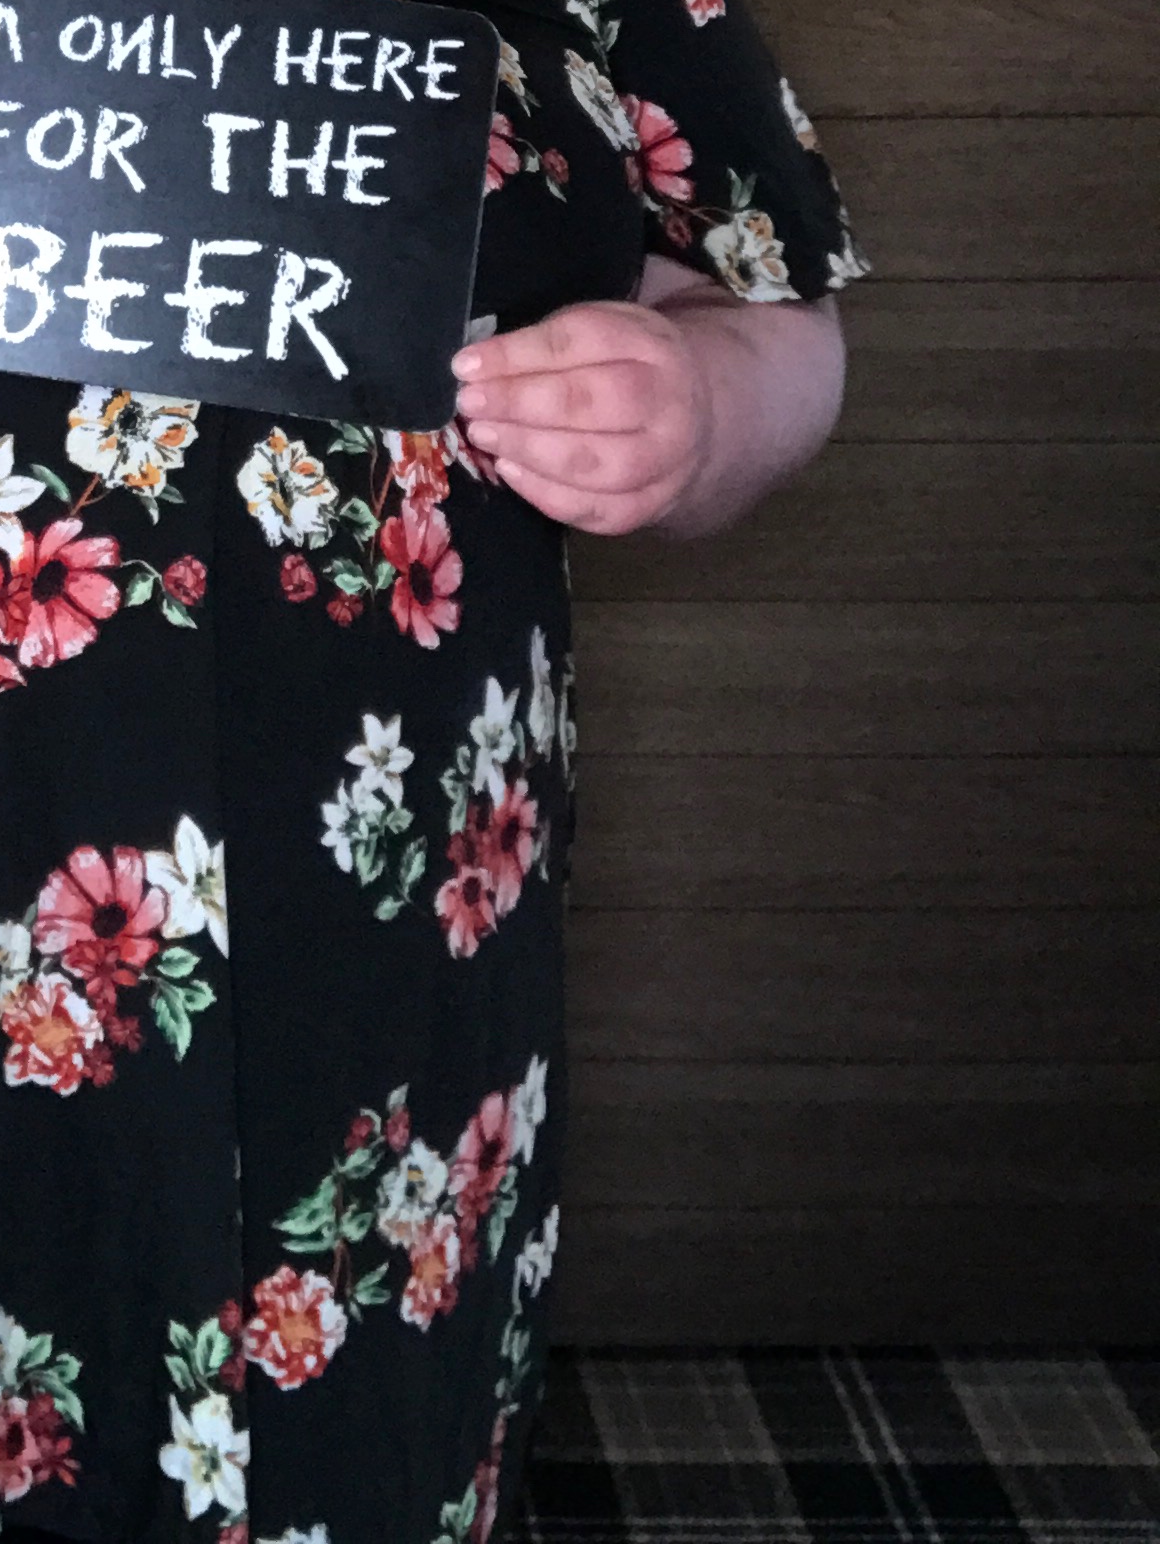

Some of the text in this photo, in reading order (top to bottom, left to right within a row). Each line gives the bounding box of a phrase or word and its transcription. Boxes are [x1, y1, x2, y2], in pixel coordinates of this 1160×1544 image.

[58, 13, 242, 90] ONLY
[272, 26, 466, 102] HERE
[202, 112, 397, 206] THE
